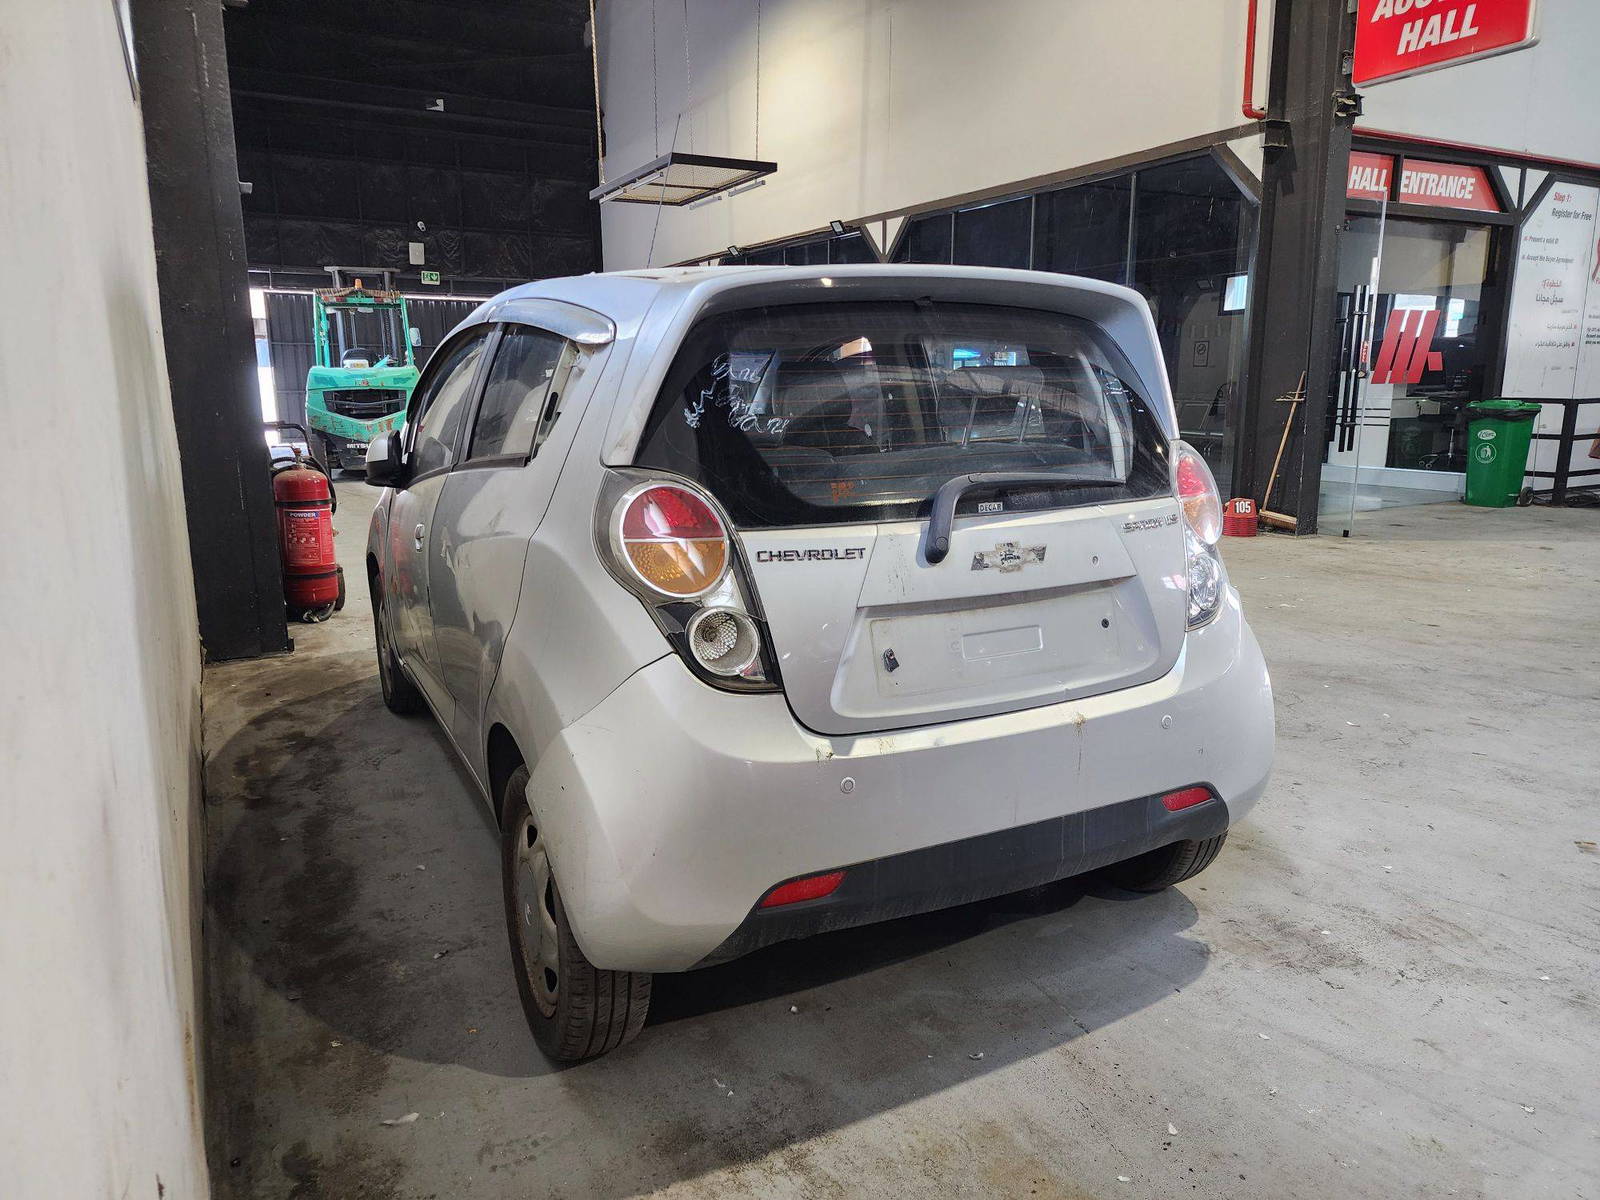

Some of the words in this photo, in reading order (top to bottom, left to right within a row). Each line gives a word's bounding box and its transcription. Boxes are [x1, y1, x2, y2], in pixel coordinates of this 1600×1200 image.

[1397, 4, 1478, 56] HALL
[1348, 165, 1388, 192] HALL
[1400, 169, 1475, 200] ENTRANCE
[1553, 191, 1566, 204] Step
[1551, 207, 1573, 220] Register
[1580, 211, 1593, 221] Free
[1235, 501, 1251, 513] 105
[757, 547, 866, 563] CHEVROLET
